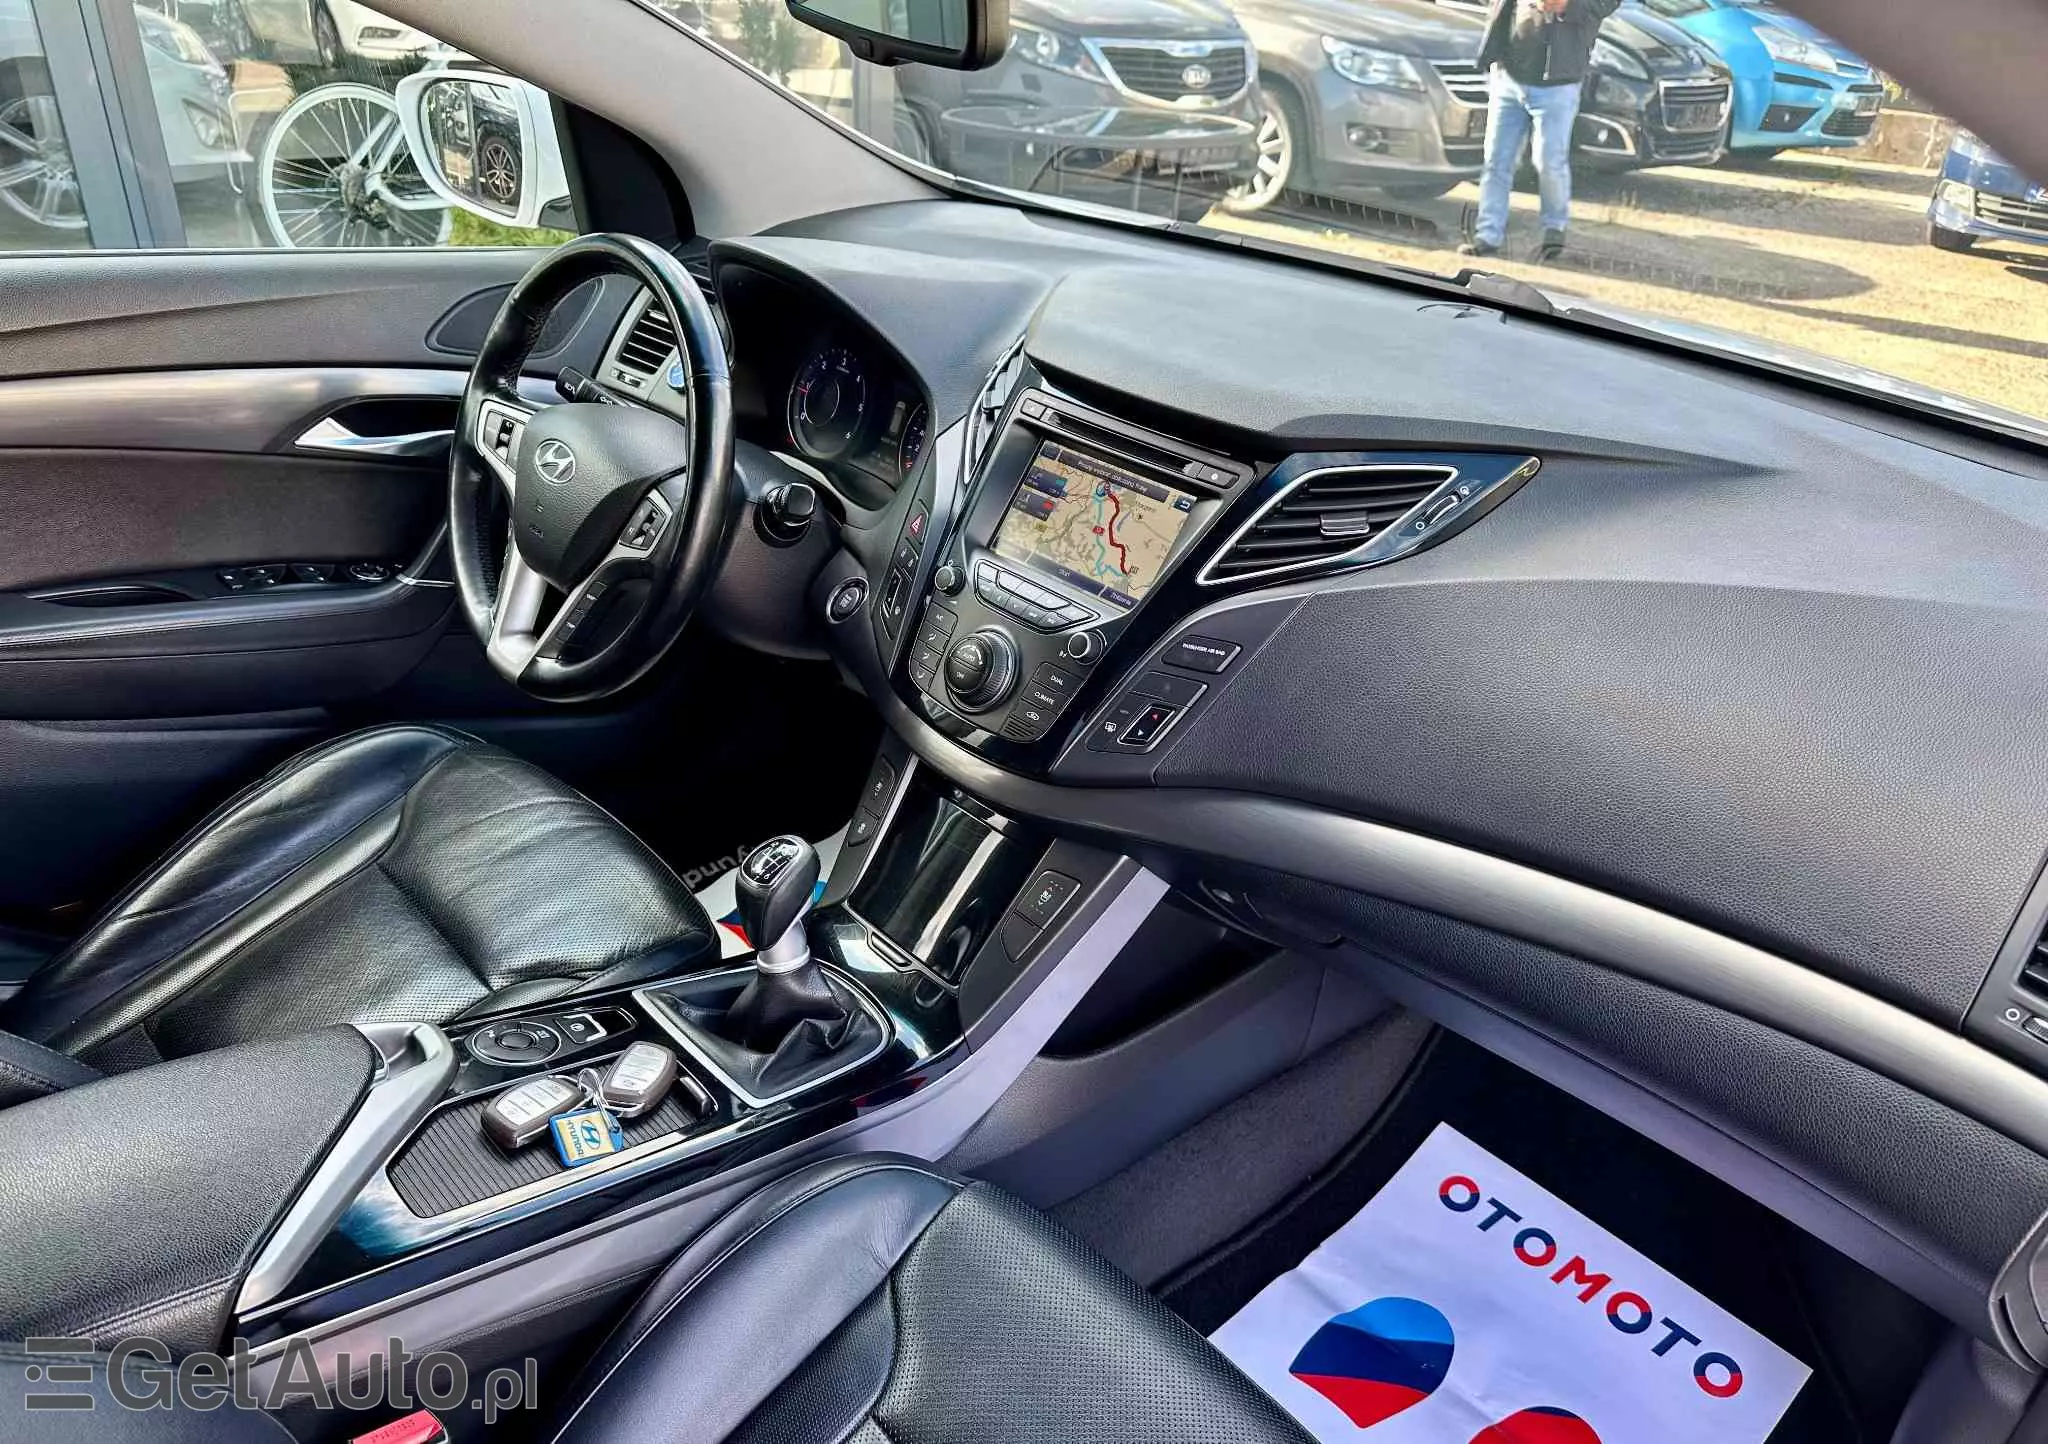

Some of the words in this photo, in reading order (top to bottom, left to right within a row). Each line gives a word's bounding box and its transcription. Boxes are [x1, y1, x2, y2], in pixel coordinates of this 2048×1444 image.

[1050, 675, 1064, 686] DUAL
[1034, 691, 1055, 705] CLIMATE
[1438, 1174, 1744, 1398] OTOMOTO
